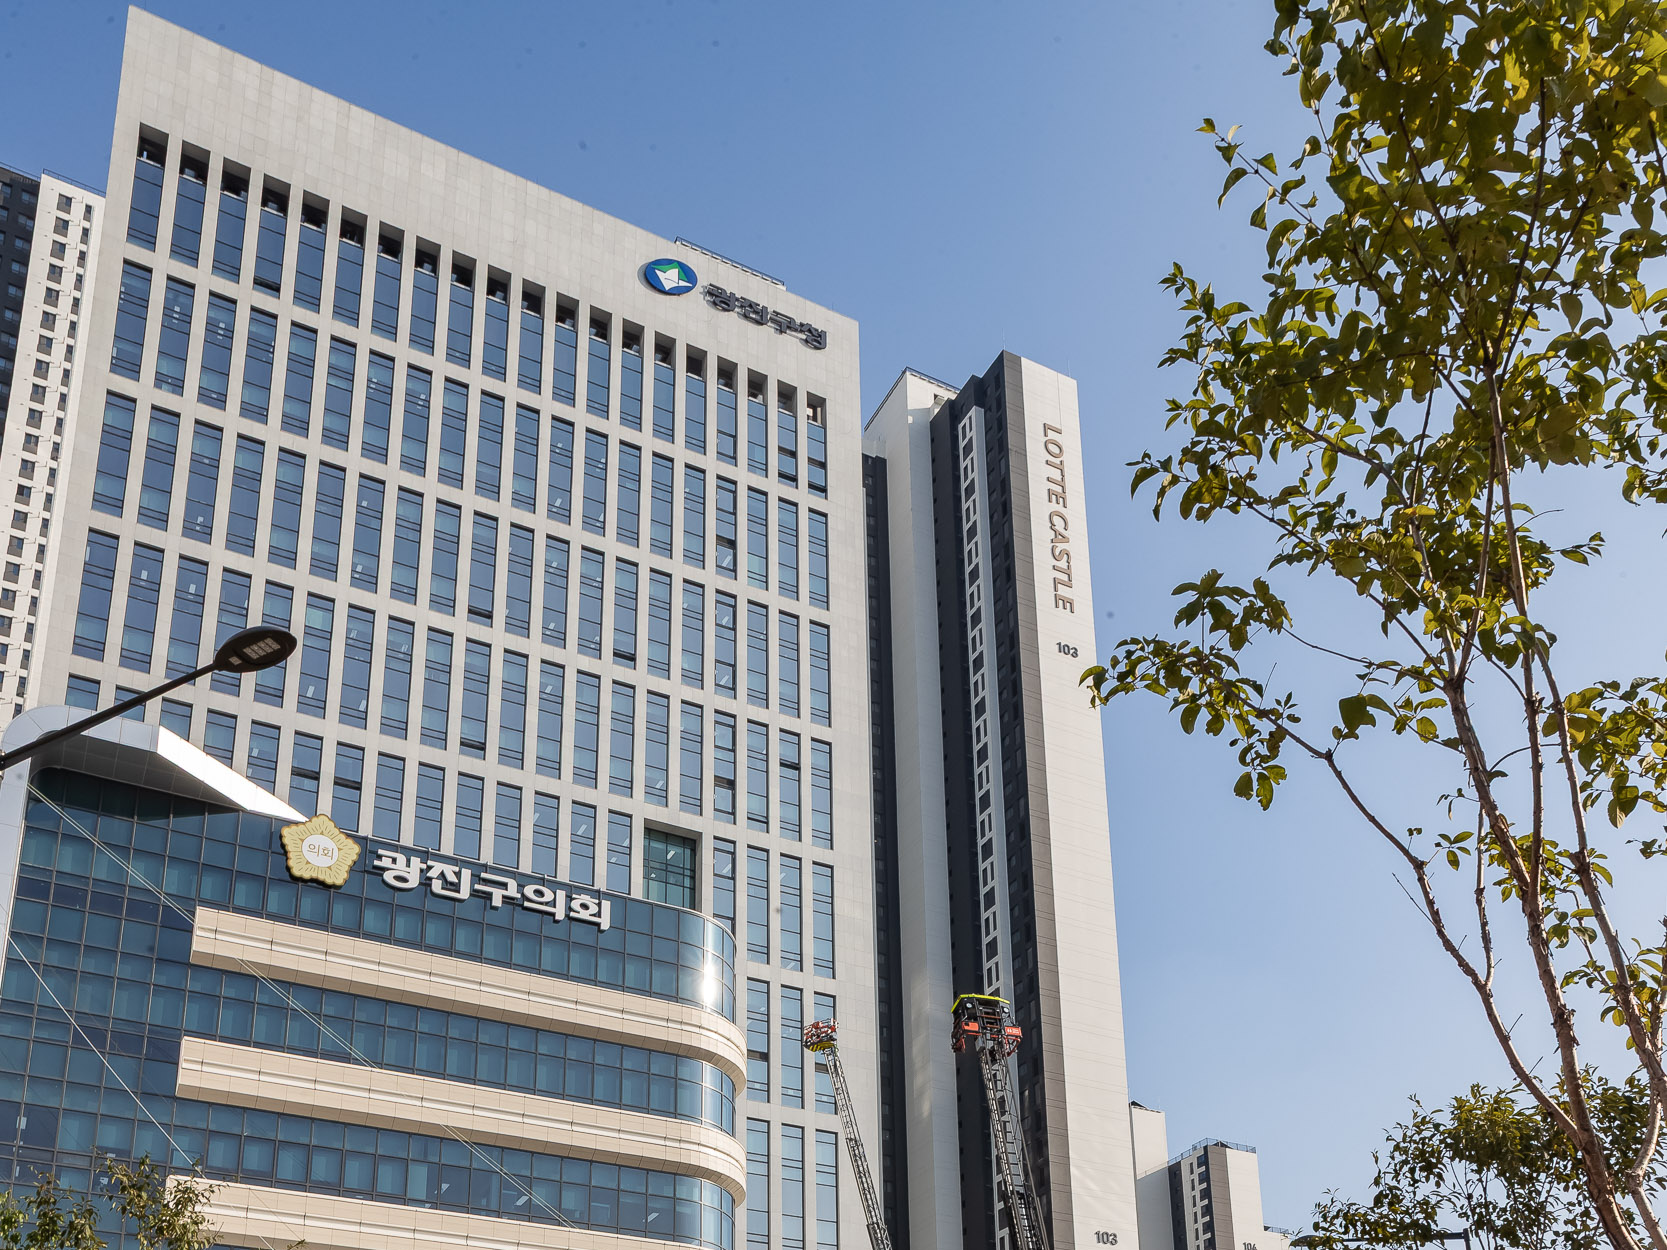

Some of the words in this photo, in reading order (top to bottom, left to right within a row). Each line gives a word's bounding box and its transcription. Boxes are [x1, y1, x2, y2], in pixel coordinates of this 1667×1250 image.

[703, 283, 827, 349] 광진구청
[1043, 422, 1067, 508] LOTTE
[1049, 510, 1075, 613] CASTLE
[1056, 641, 1079, 658] 103
[307, 843, 334, 861] 의회
[373, 849, 612, 931] 광진구의회
[1095, 1231, 1118, 1245] 103
